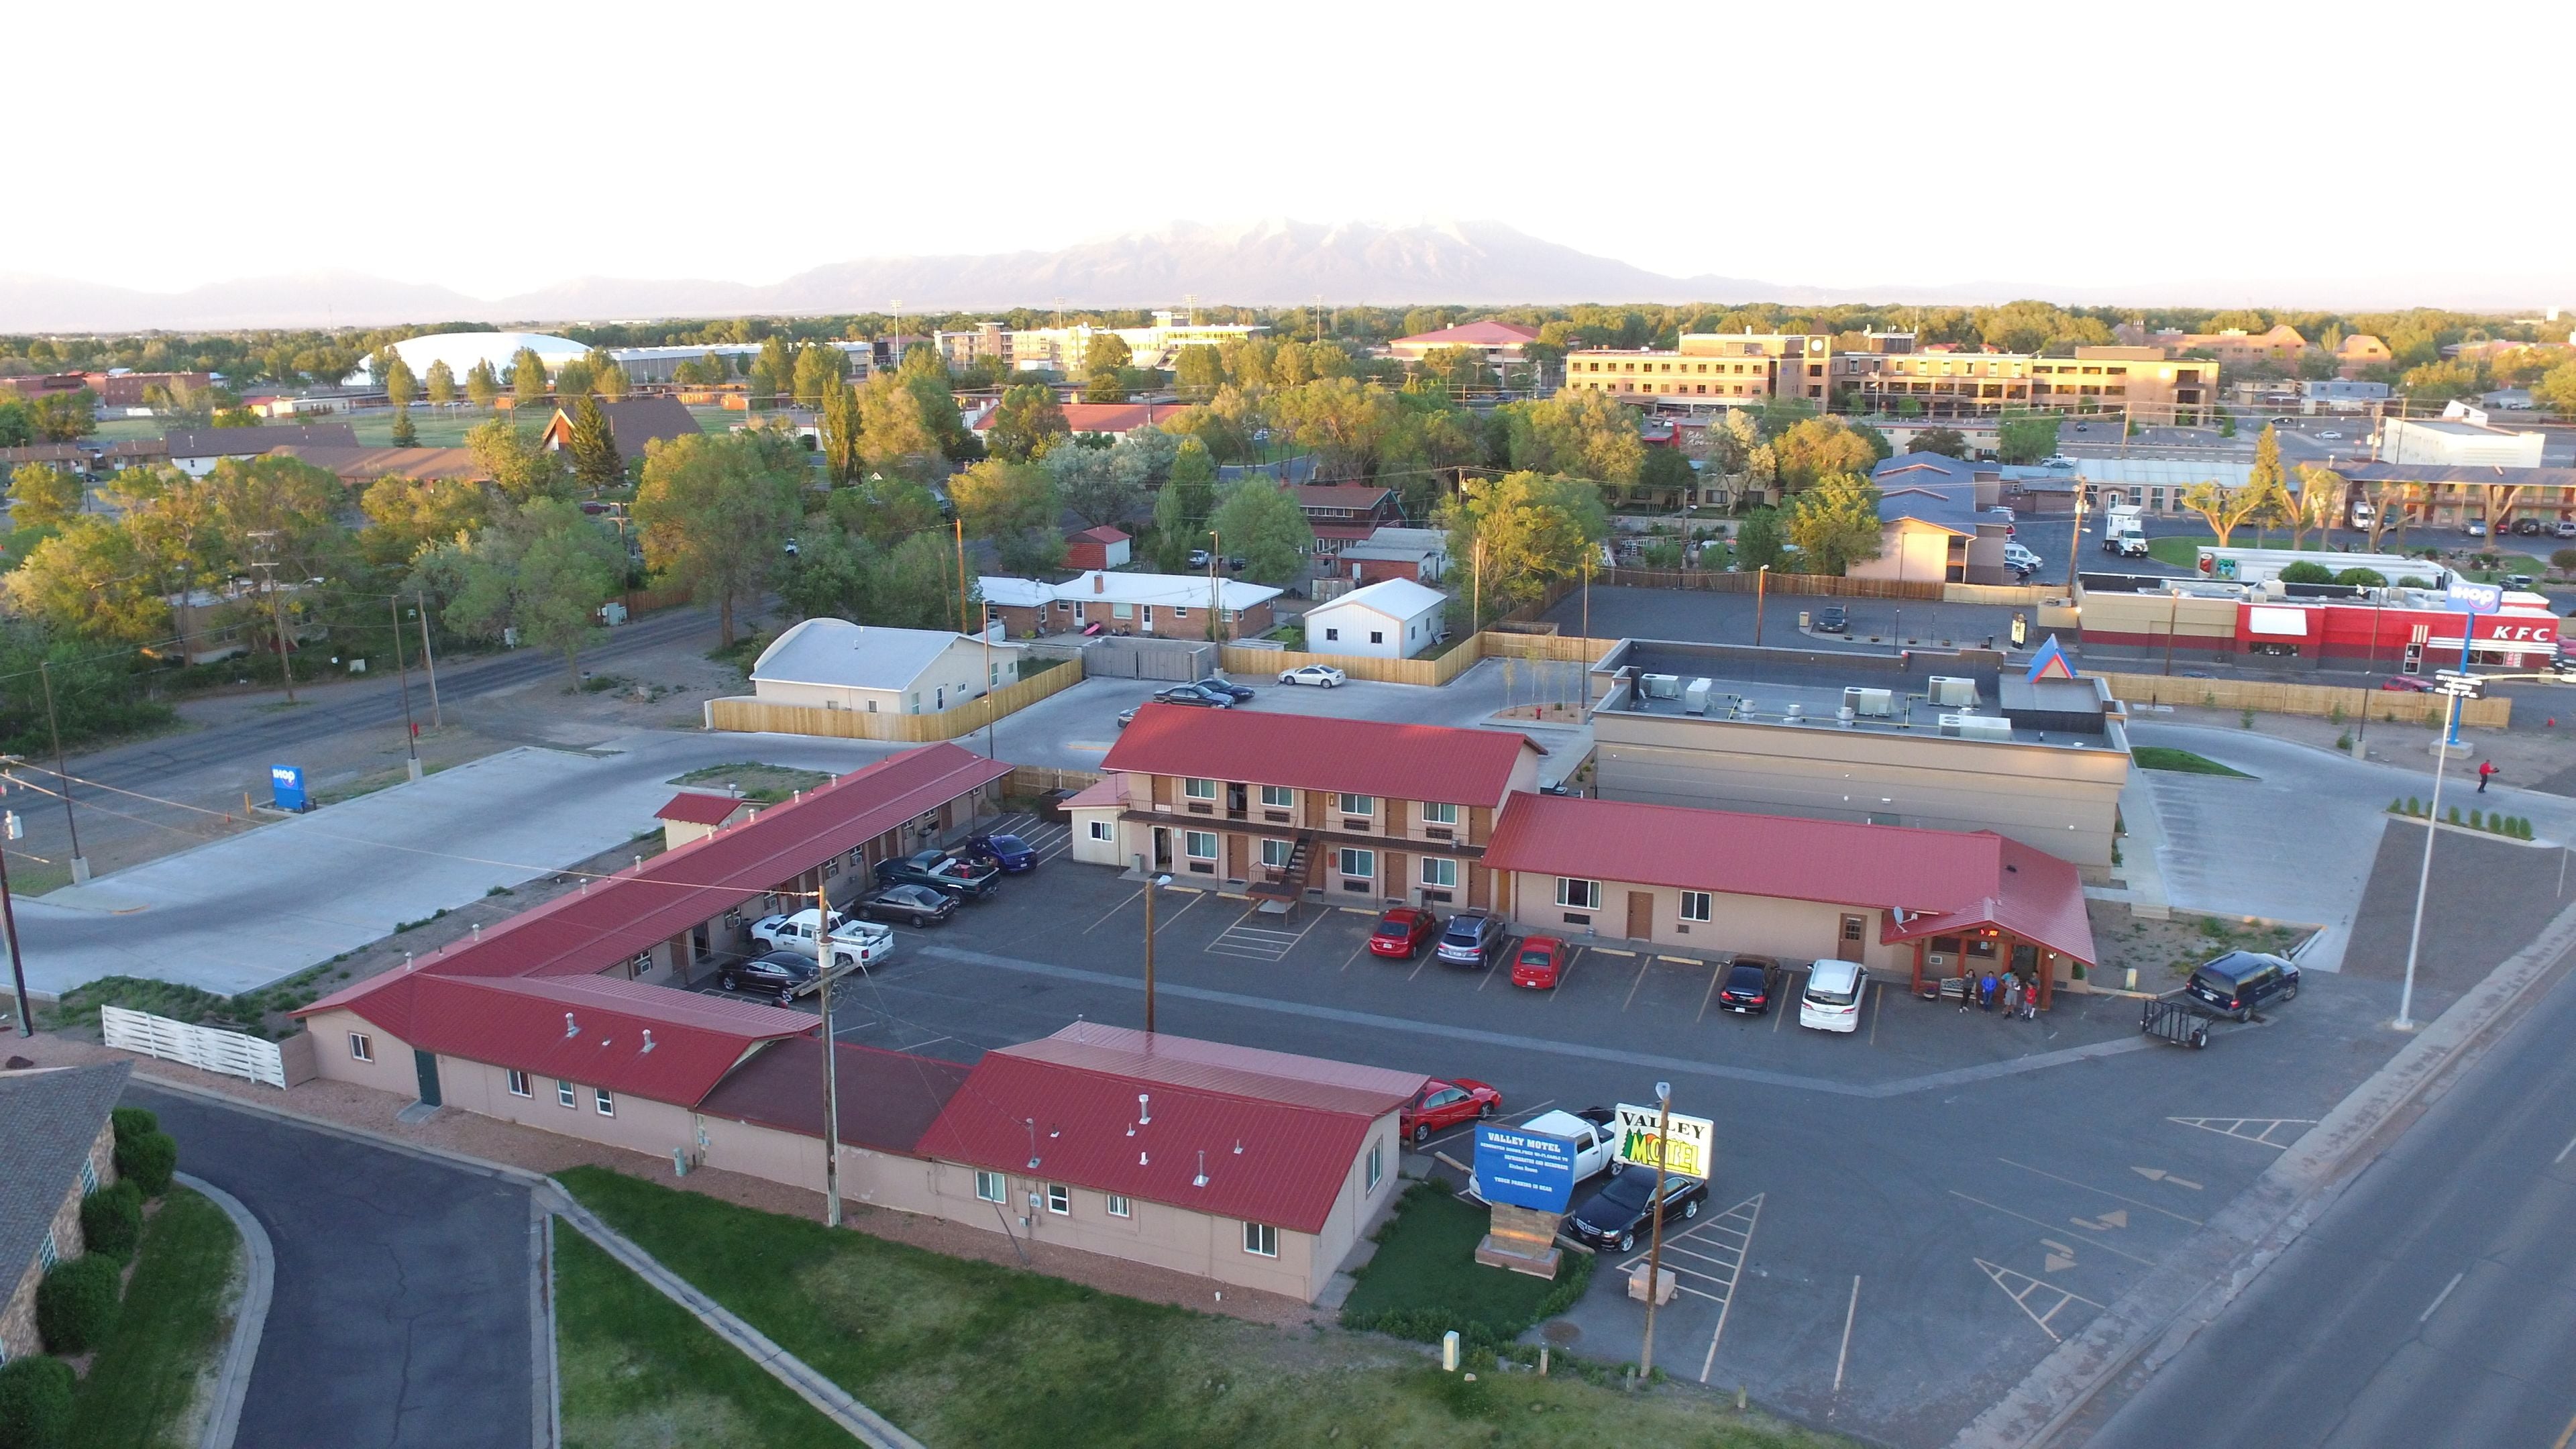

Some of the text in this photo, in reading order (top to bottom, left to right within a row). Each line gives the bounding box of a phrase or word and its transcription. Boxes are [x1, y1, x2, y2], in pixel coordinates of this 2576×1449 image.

[2491, 626, 2551, 641] KFC
[1621, 1111, 1705, 1140] VALLEY
[1487, 1132, 1561, 1153] VALLEY MOTEL
[1628, 1132, 1701, 1175] MOTEL
